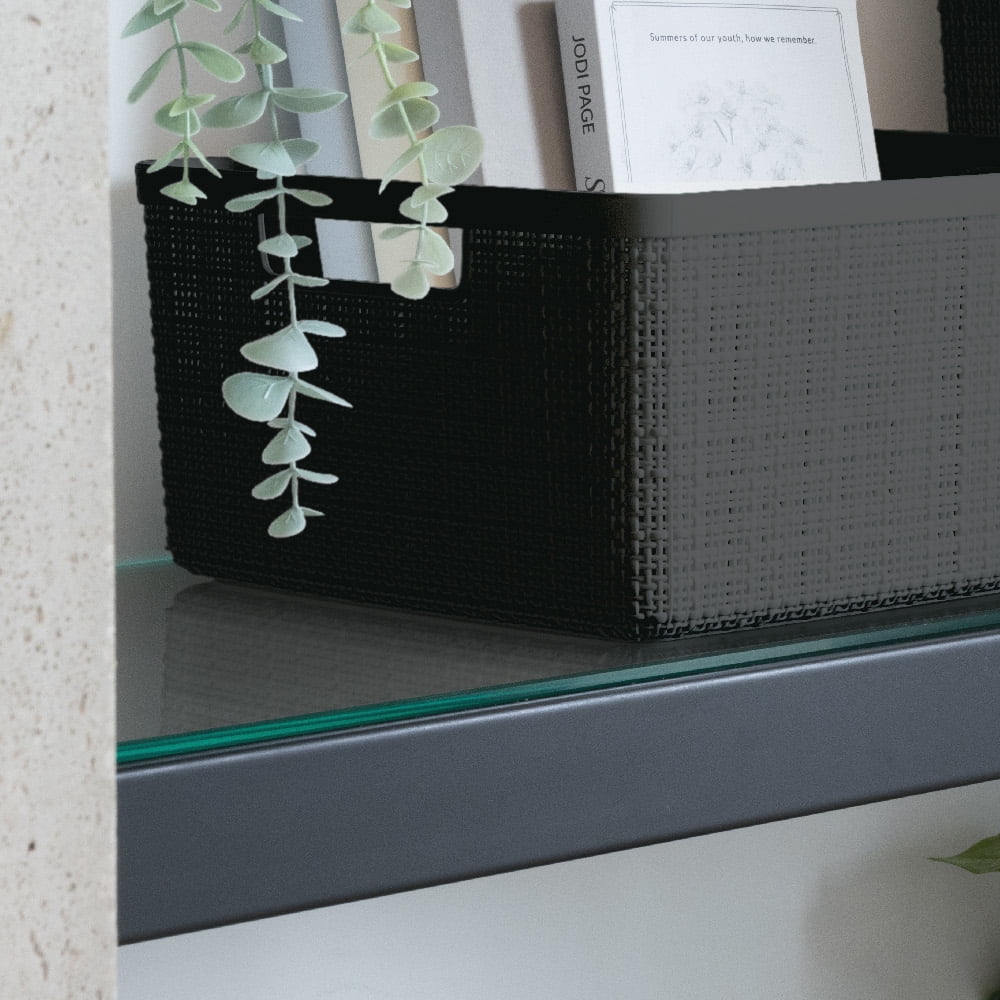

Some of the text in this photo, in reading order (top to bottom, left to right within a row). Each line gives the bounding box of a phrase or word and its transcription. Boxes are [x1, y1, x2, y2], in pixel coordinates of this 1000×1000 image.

[649, 32, 817, 45] Summers of our youth, how we remember.
[572, 35, 595, 136] JODI PAGE
